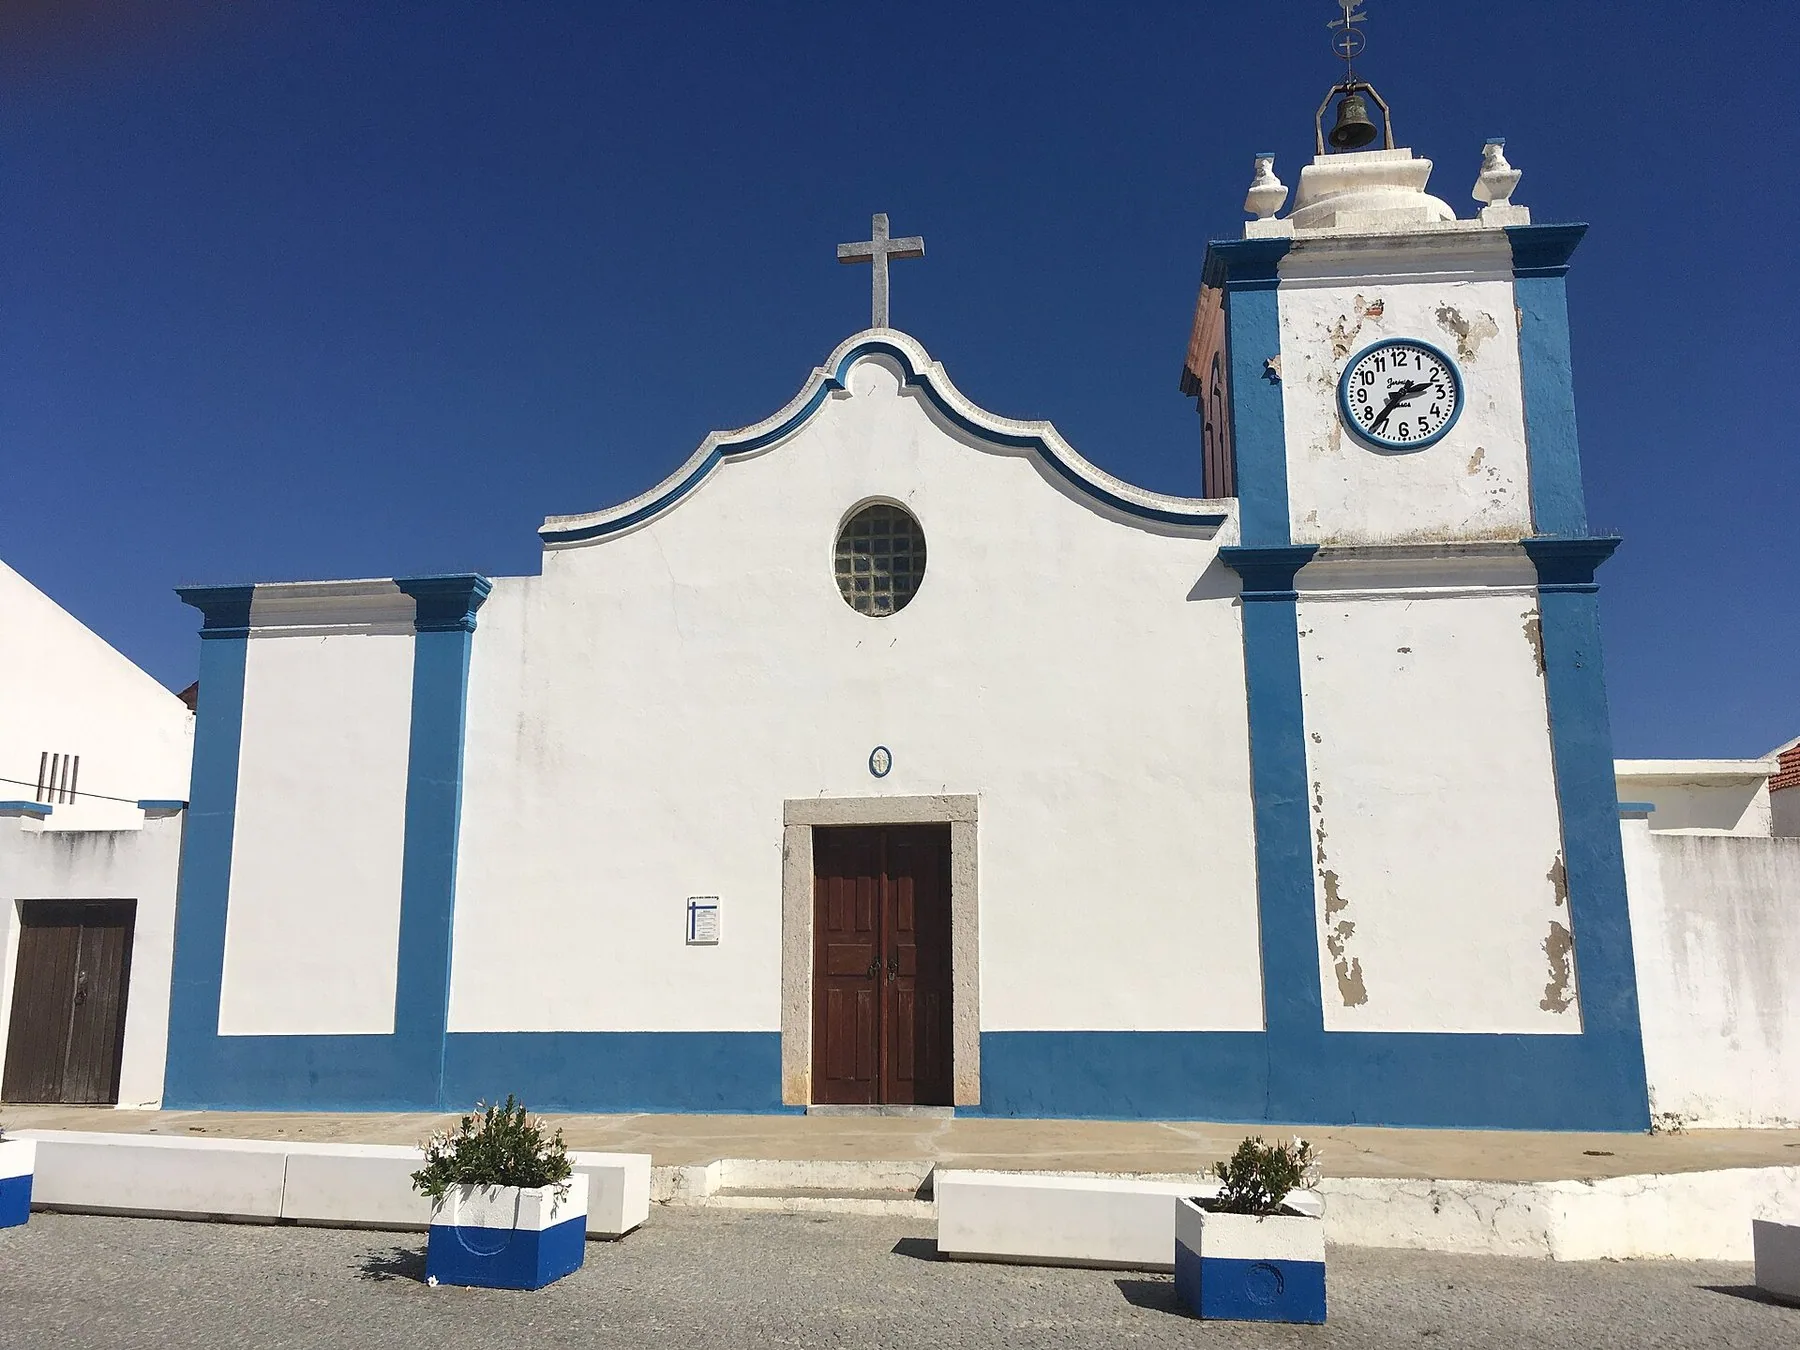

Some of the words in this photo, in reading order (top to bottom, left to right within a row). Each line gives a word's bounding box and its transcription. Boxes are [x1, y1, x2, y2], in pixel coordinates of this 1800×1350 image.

[1374, 356, 1386, 372] 11
[1391, 351, 1407, 367] 12
[1415, 355, 1421, 370] 1
[1359, 370, 1375, 386] 10
[1429, 367, 1440, 383] 2
[1357, 388, 1367, 403] 9
[1435, 384, 1446, 399] 3
[1364, 405, 1374, 421] 8
[1430, 403, 1441, 418] 4
[1399, 422, 1409, 437] 6
[1418, 416, 1429, 432] 5
